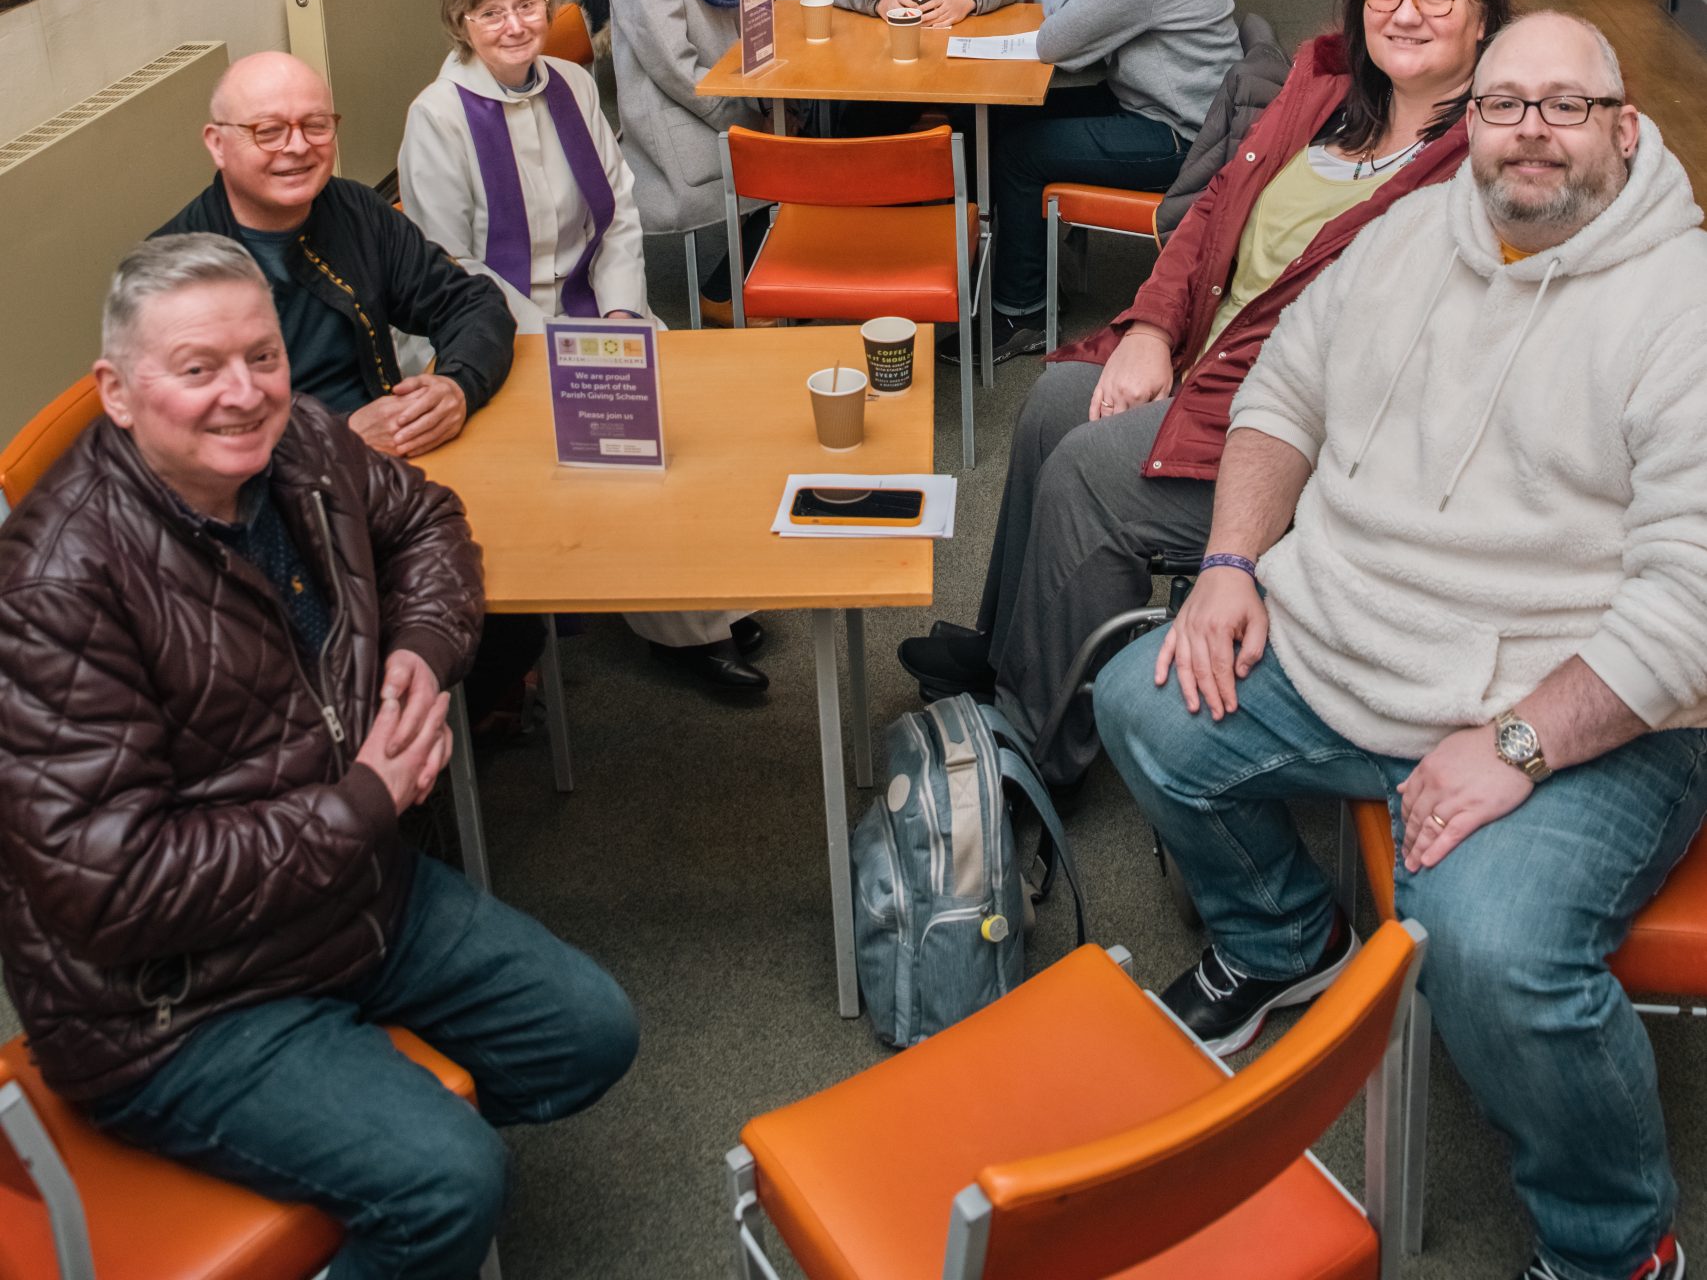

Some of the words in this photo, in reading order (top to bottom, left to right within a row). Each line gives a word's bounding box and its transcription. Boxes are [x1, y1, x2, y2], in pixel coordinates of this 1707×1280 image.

[877, 348, 907, 356] COFFEE
[575, 372, 588, 380] We
[605, 373, 631, 381] proud
[594, 383, 611, 391] part
[622, 383, 637, 391] the
[560, 391, 586, 399] Parish
[587, 391, 615, 401] Giving
[615, 392, 649, 401] Scheme
[578, 410, 605, 419] Please
[606, 411, 622, 420] join
